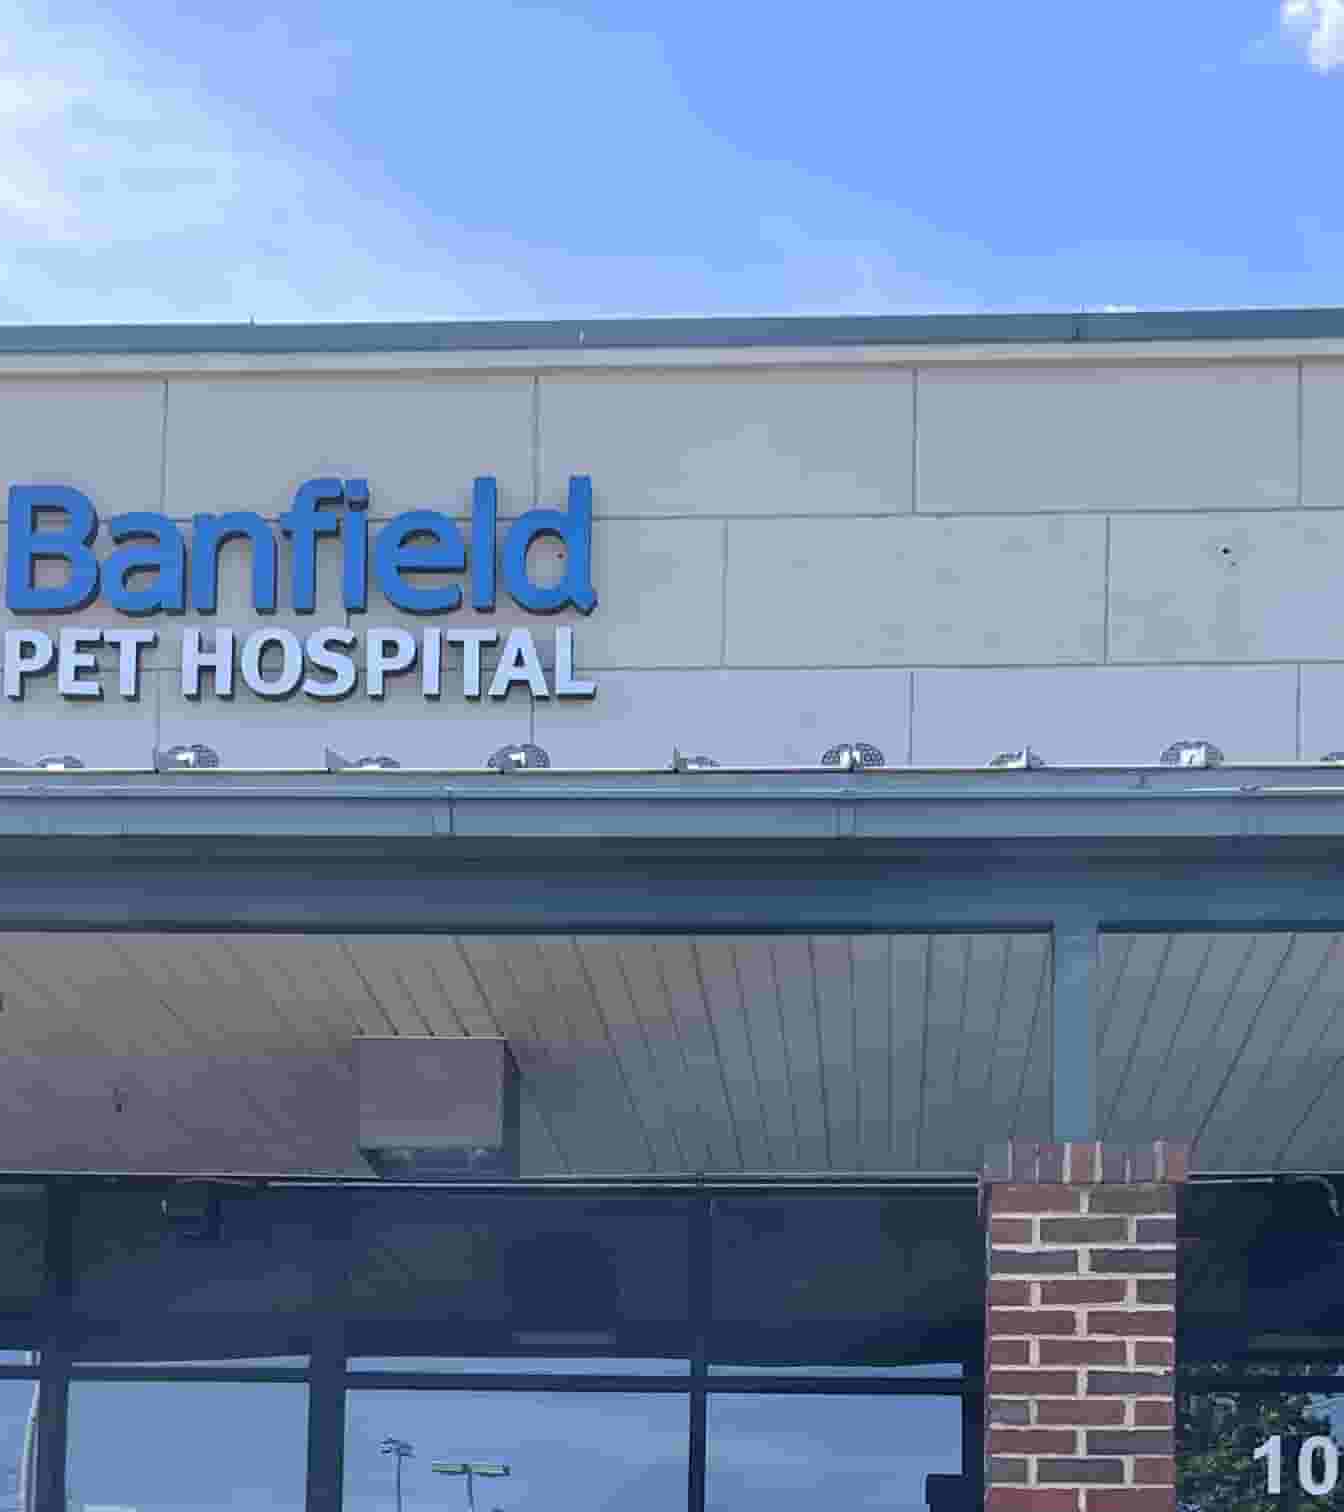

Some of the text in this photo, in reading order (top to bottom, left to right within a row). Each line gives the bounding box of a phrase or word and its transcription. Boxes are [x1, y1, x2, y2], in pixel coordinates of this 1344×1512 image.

[5, 476, 598, 614] Banfield
[3, 626, 598, 701] PET HOSPITAL
